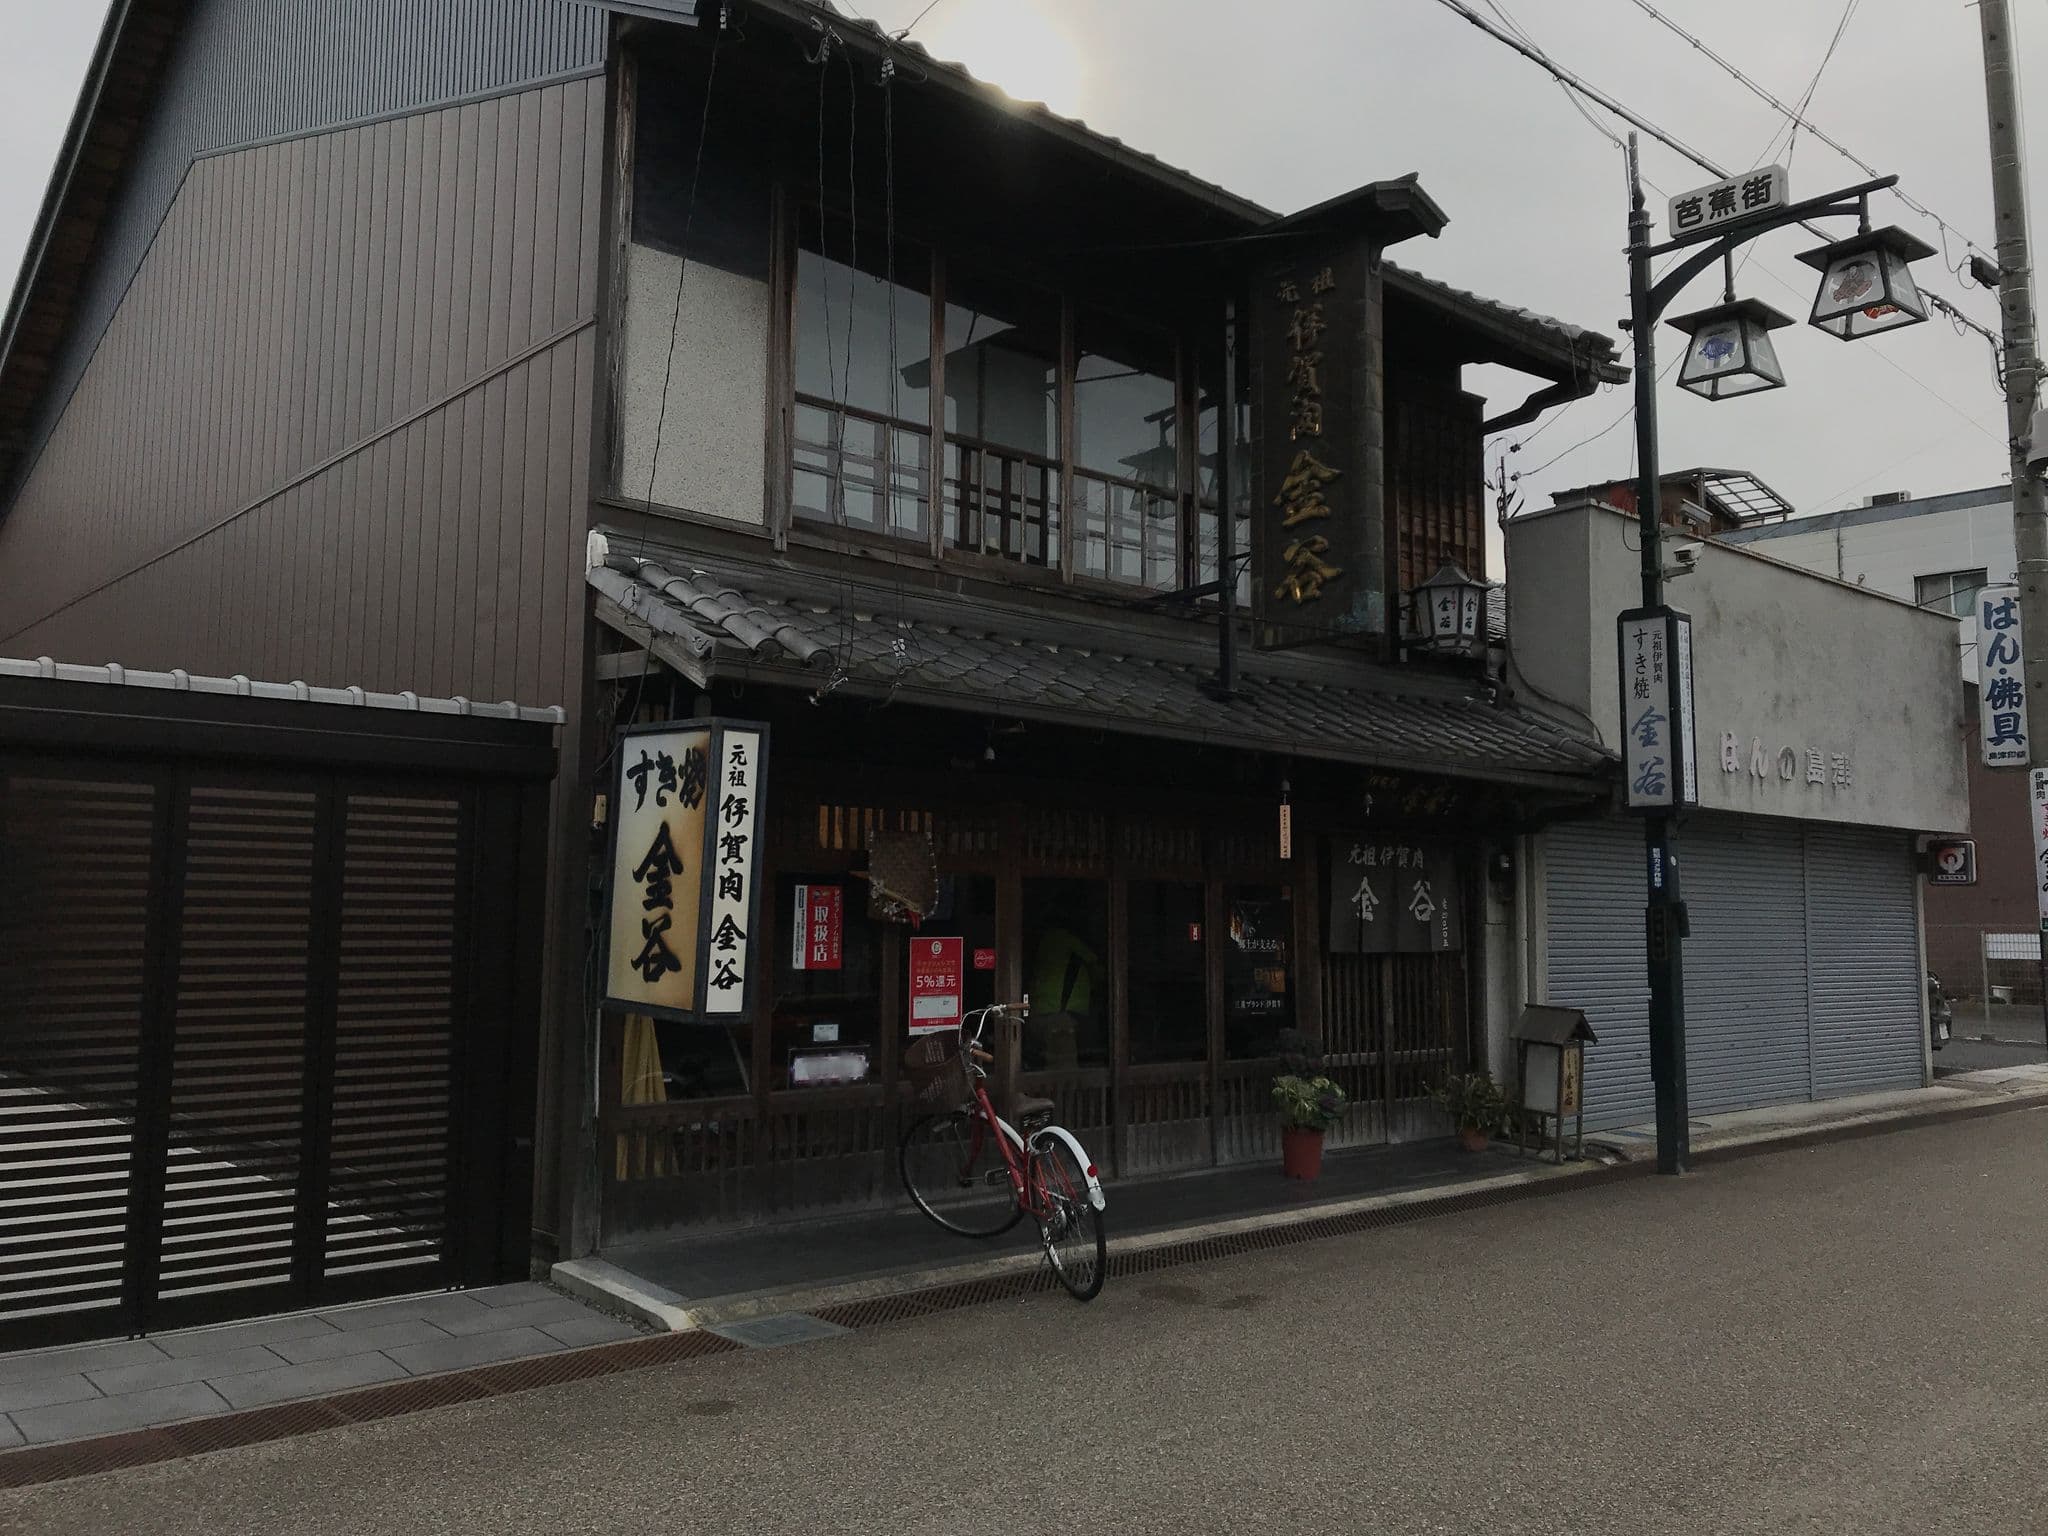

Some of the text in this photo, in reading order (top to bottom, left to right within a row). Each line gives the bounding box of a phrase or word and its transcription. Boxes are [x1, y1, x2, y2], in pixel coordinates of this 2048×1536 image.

[1675, 174, 1772, 228] 芭蕉街
[1274, 450, 1343, 604] 金谷
[1633, 627, 1650, 700] すき焼
[1652, 630, 1665, 684] 元祖伊賀肉
[1631, 705, 1666, 796] 金谷
[1720, 731, 1851, 787] はんの島津
[1348, 843, 1424, 869] 元祖伊賀肉
[631, 820, 684, 983] 金谷
[1351, 876, 1436, 922] 金谷
[710, 913, 747, 990] 金谷
[814, 906, 829, 962] 取扱店
[916, 975, 957, 988] 5%還元
